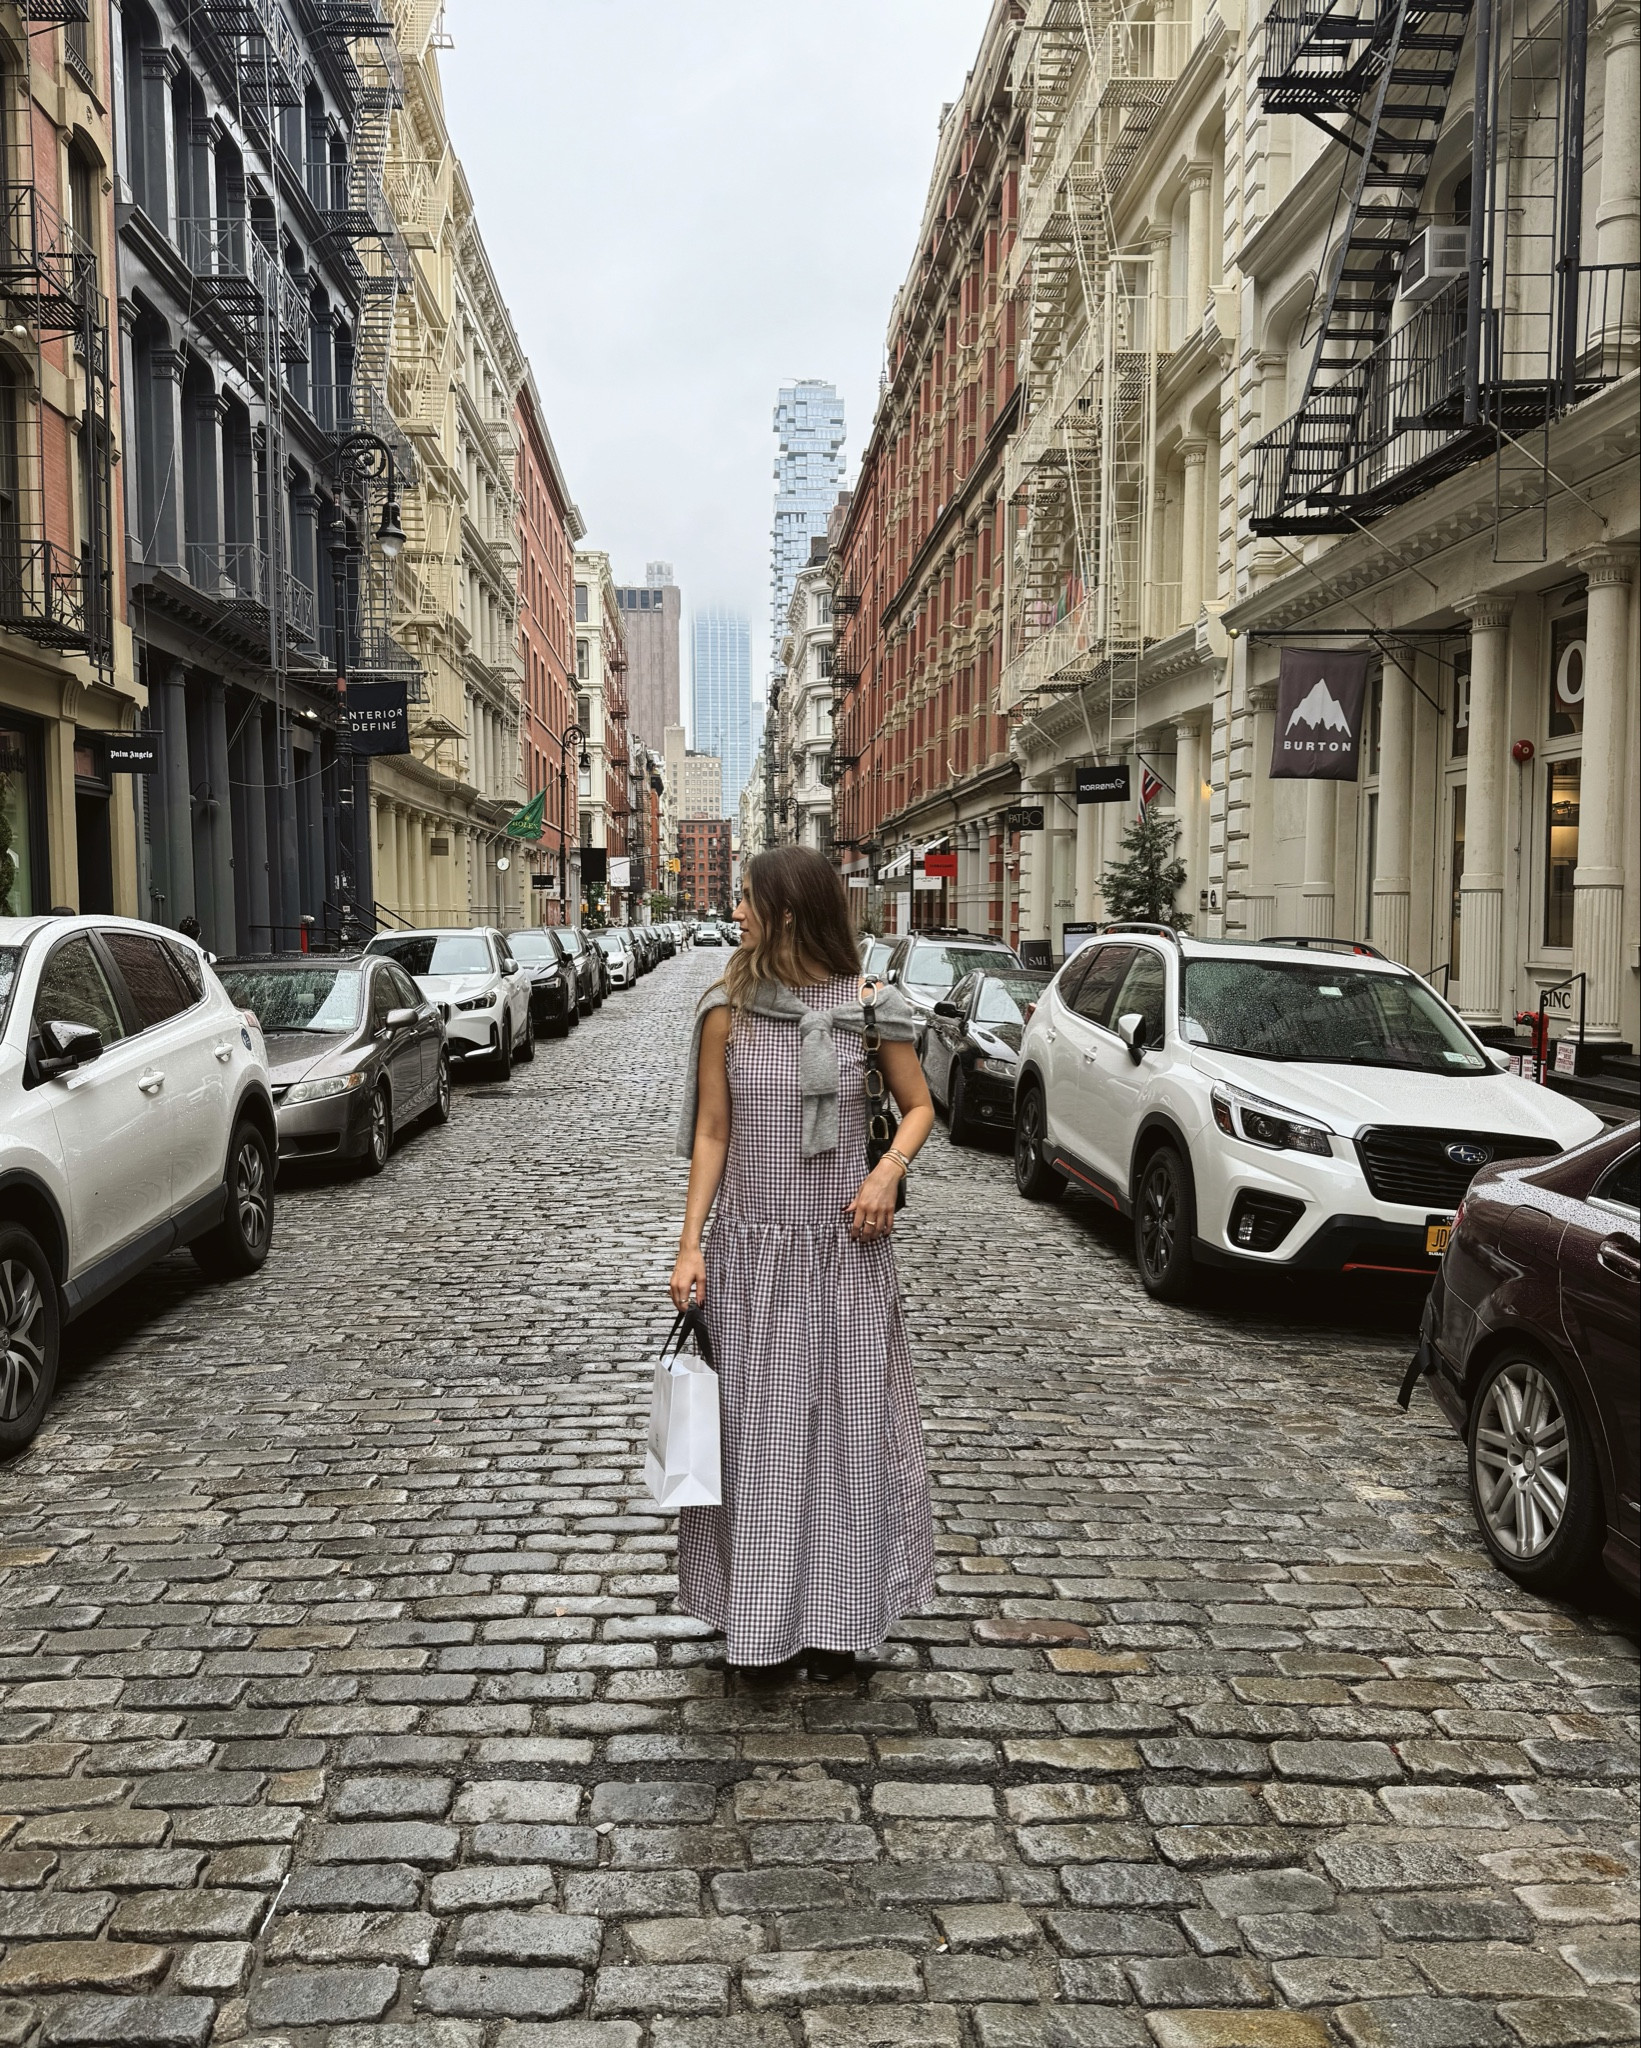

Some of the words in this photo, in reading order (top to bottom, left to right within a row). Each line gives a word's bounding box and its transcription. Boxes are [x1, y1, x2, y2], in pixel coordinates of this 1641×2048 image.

[349, 708, 403, 720] NTERIOR
[352, 721, 397, 731] DEFINE
[1283, 741, 1352, 752] BURTON
[110, 750, 129, 759] Palm
[129, 750, 153, 759] Angels
[512, 820, 539, 830] ROLEX
[1431, 1229, 1451, 1247] JD
